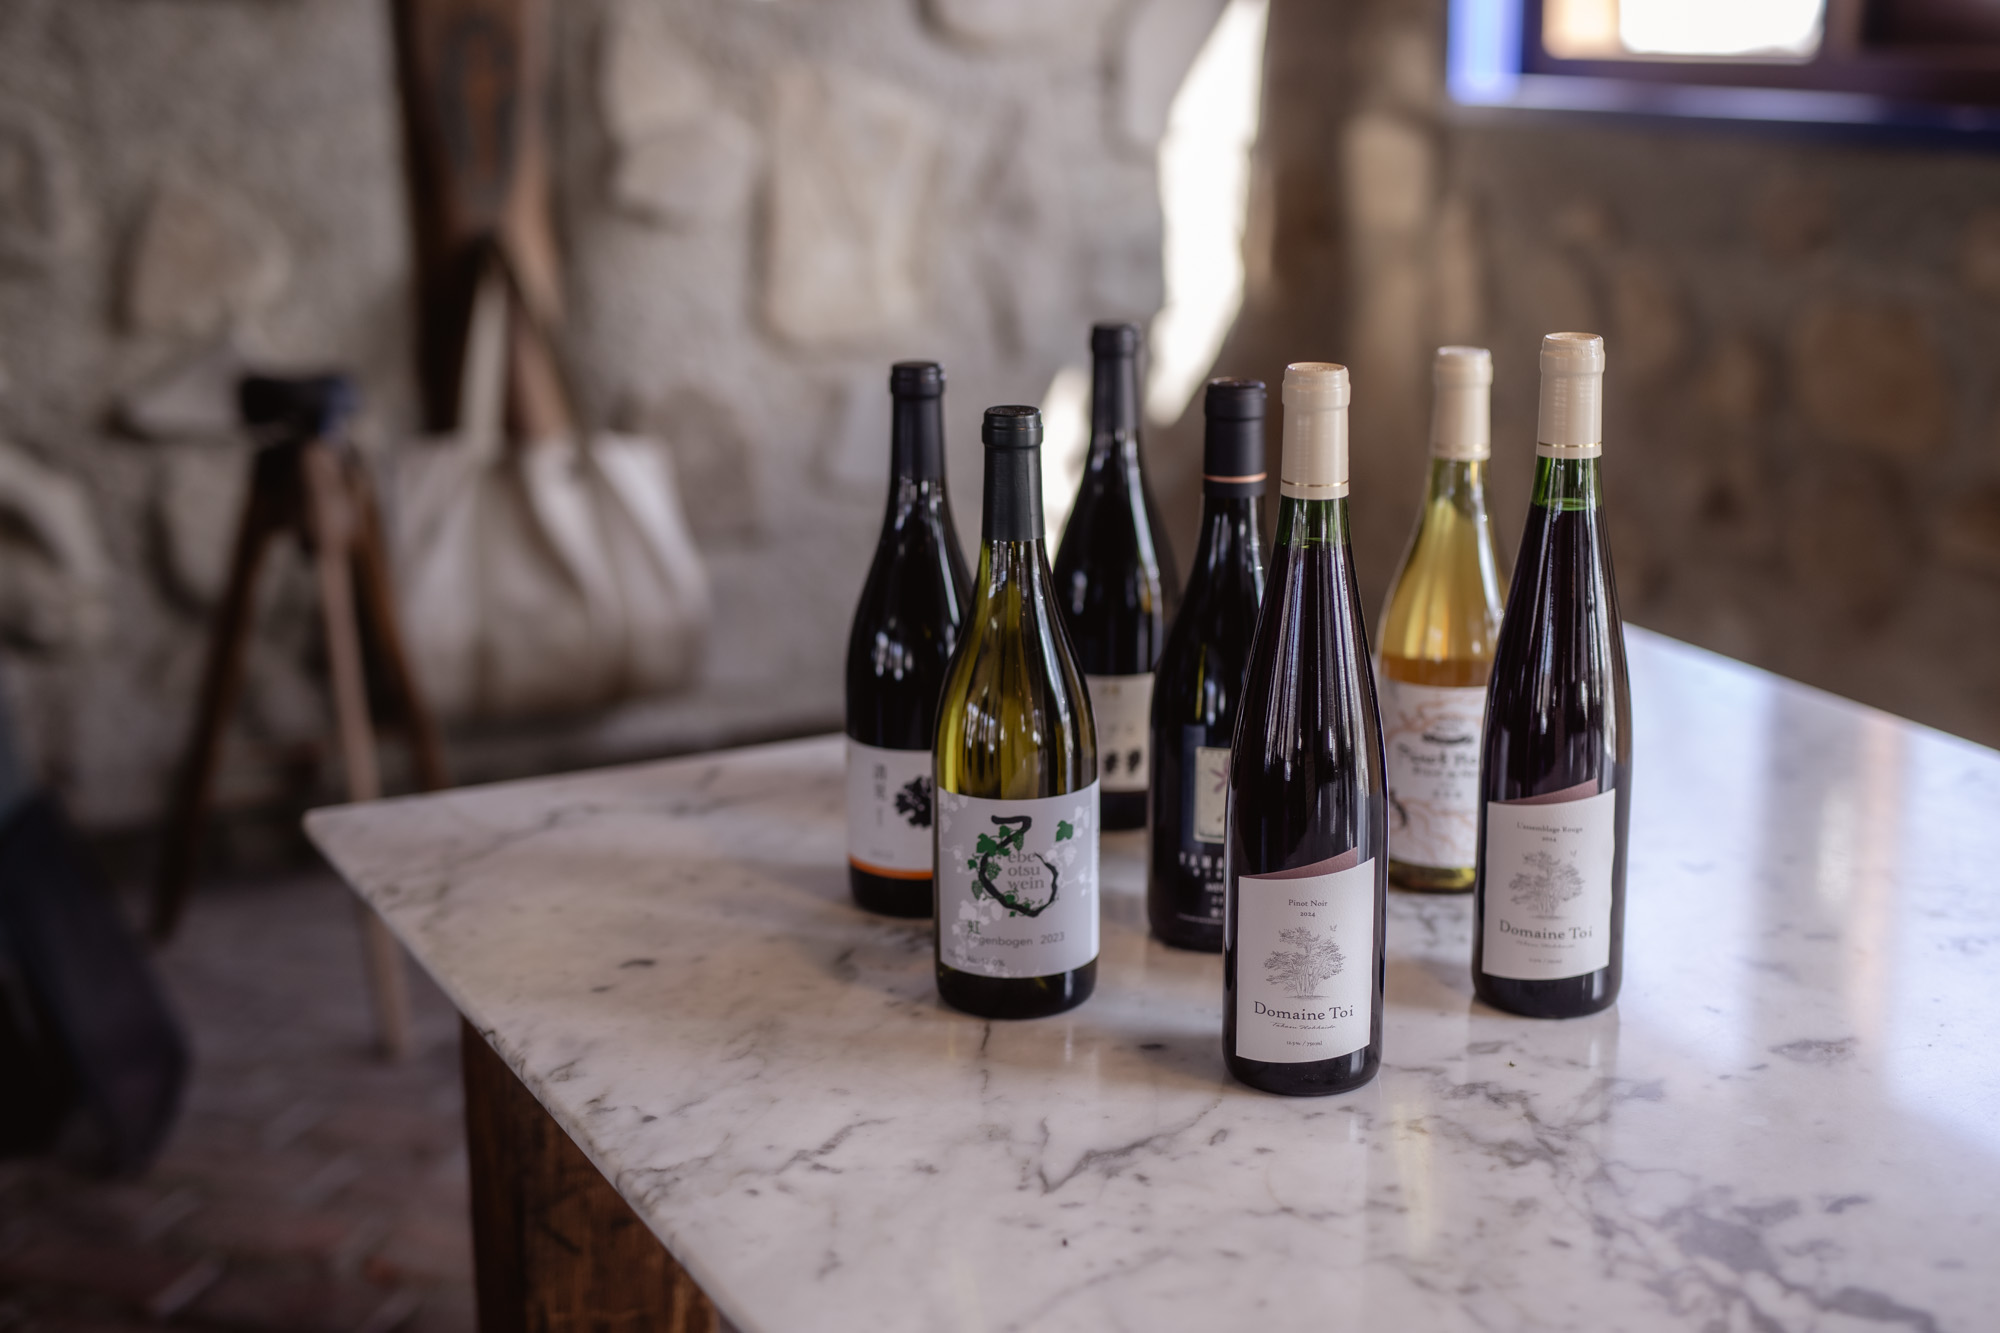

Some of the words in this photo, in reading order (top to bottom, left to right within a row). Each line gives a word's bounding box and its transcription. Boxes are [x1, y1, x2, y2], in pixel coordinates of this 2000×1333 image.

[1007, 865, 1040, 877] otsu
[1007, 877, 1045, 890] wein
[1288, 899, 1308, 907] Pinot
[1500, 920, 1566, 939] Domaine
[1569, 925, 1593, 939] Toi
[966, 933, 1033, 948] Regenbogen
[1040, 931, 1065, 945] 2023
[1254, 1001, 1325, 1021] Domaine
[1329, 1005, 1354, 1019] Toi
